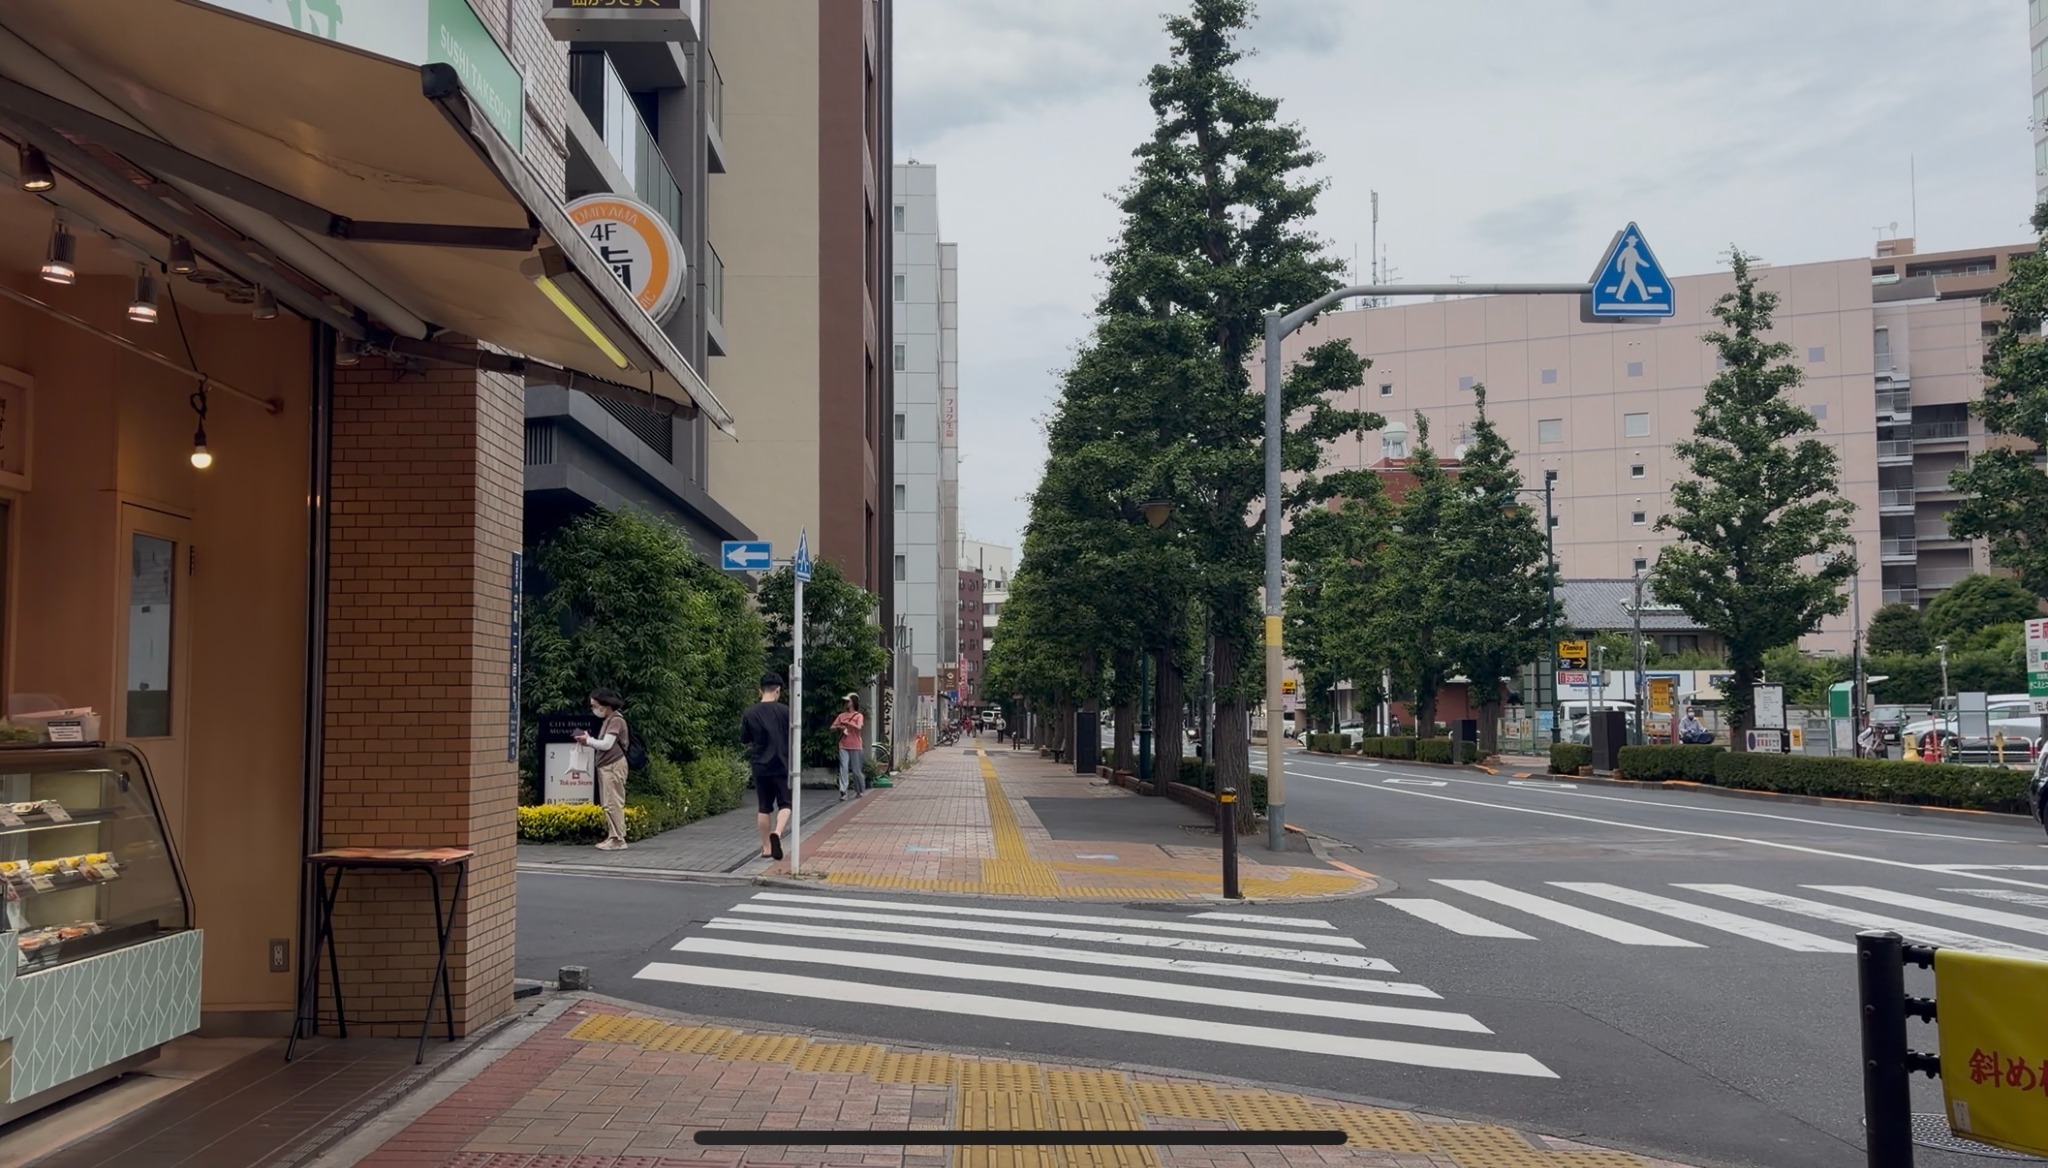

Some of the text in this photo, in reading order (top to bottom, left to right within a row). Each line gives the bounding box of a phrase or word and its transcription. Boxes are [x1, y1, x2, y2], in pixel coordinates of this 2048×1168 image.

[440, 24, 512, 131] SUSHI TAKEOUT
[590, 222, 617, 241] 4F
[550, 751, 555, 759] 2
[1968, 1047, 2048, 1098] 斜め
